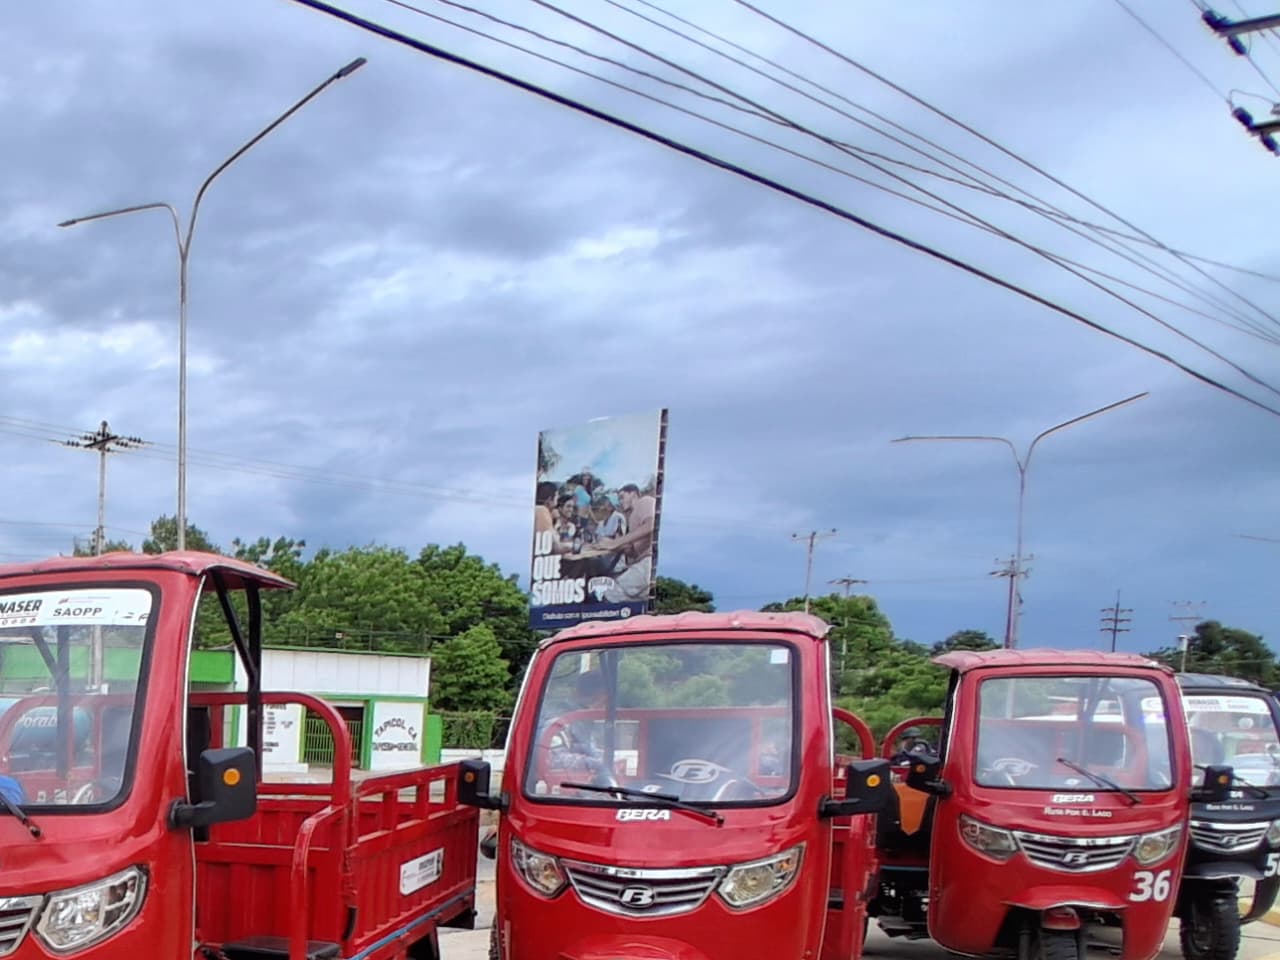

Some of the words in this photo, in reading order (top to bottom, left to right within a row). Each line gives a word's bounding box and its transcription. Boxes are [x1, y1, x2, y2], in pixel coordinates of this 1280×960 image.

[535, 531, 553, 555] LO
[533, 555, 562, 580] QUE
[532, 578, 586, 606] SOMOS
[52, 607, 103, 617] SAOPP
[616, 809, 671, 821] BERA
[1264, 853, 1280, 877] 5
[1129, 870, 1171, 902] 36
